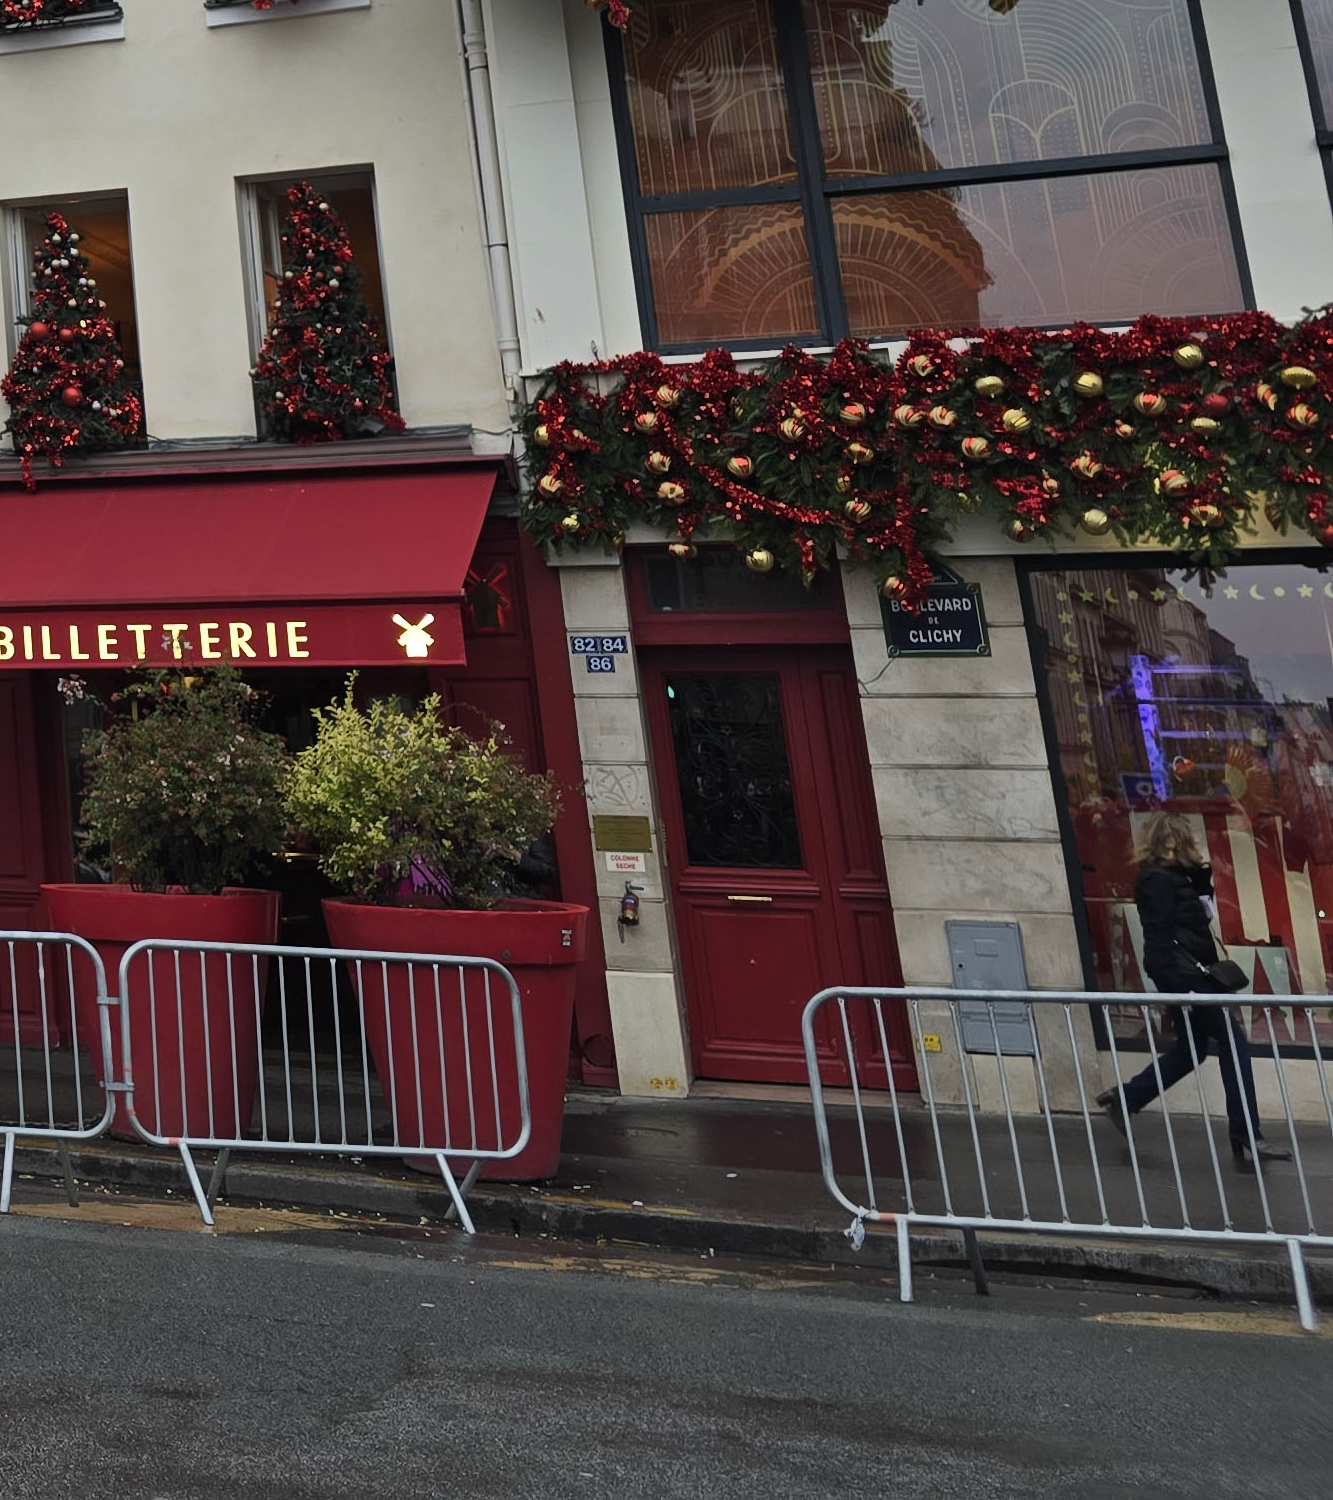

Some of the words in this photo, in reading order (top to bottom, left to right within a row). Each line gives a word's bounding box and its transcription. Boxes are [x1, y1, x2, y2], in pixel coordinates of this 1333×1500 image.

[927, 616, 939, 625] DE
[909, 629, 963, 643] CLICHY
[573, 637, 596, 652] 82
[602, 637, 625, 652] 84
[589, 657, 612, 671] 86
